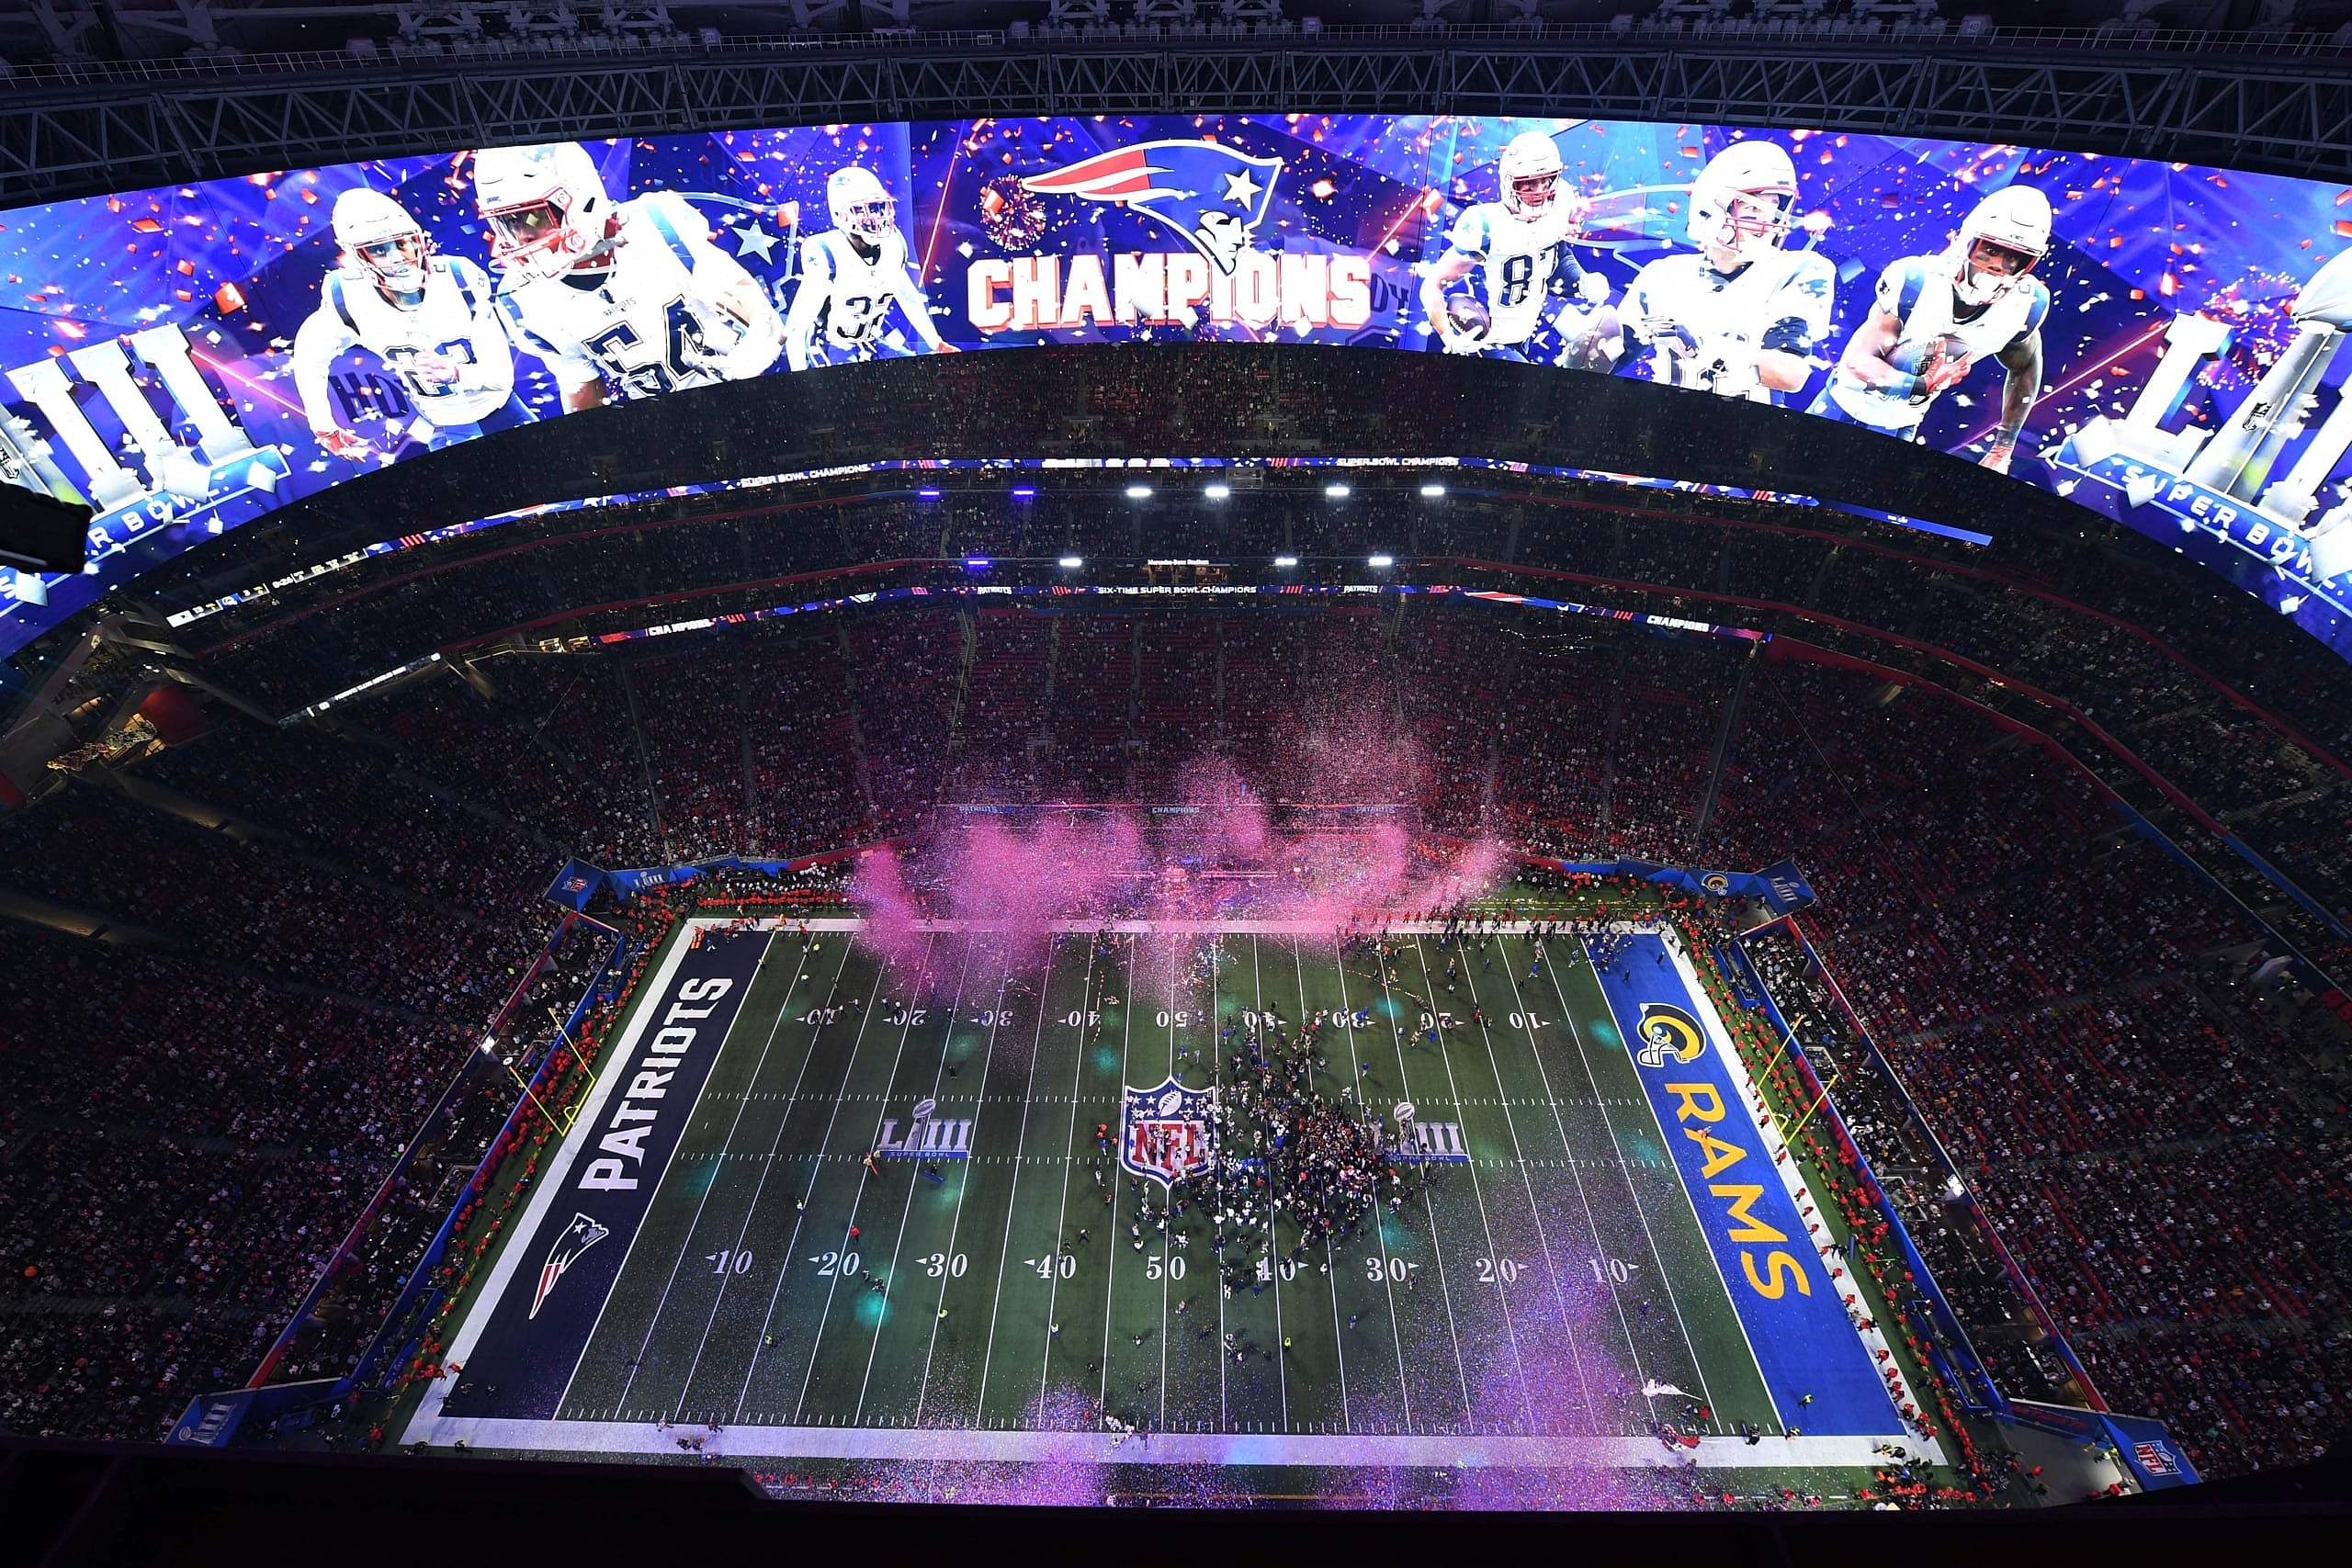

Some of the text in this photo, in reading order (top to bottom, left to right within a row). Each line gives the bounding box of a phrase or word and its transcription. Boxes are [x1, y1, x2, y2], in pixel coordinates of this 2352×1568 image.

[967, 252, 1372, 332] CHAMPIONS
[1373, 457, 1400, 467] BOWL
[778, 470, 809, 483] BOWL
[1098, 585, 1257, 594] SIX-TIME SUPER BOWL CHAMPIONS
[1068, 1010, 1101, 1027] 40
[1156, 1010, 1188, 1028] 50
[1510, 1012, 1543, 1029] 10
[578, 977, 733, 1191] PATRIOTS
[876, 1118, 972, 1150] LIII
[1132, 1123, 1205, 1171] NFL
[1664, 1082, 1812, 1301] RAMS
[713, 1250, 753, 1274] 10
[817, 1252, 860, 1276] 20
[927, 1253, 967, 1278] 30
[1036, 1255, 1077, 1279] 40
[1147, 1256, 1186, 1280] 50
[1366, 1258, 1407, 1282] 30
[1476, 1258, 1517, 1282] 20
[1589, 1258, 1628, 1283] 10
[2136, 1444, 2167, 1473] NFL
